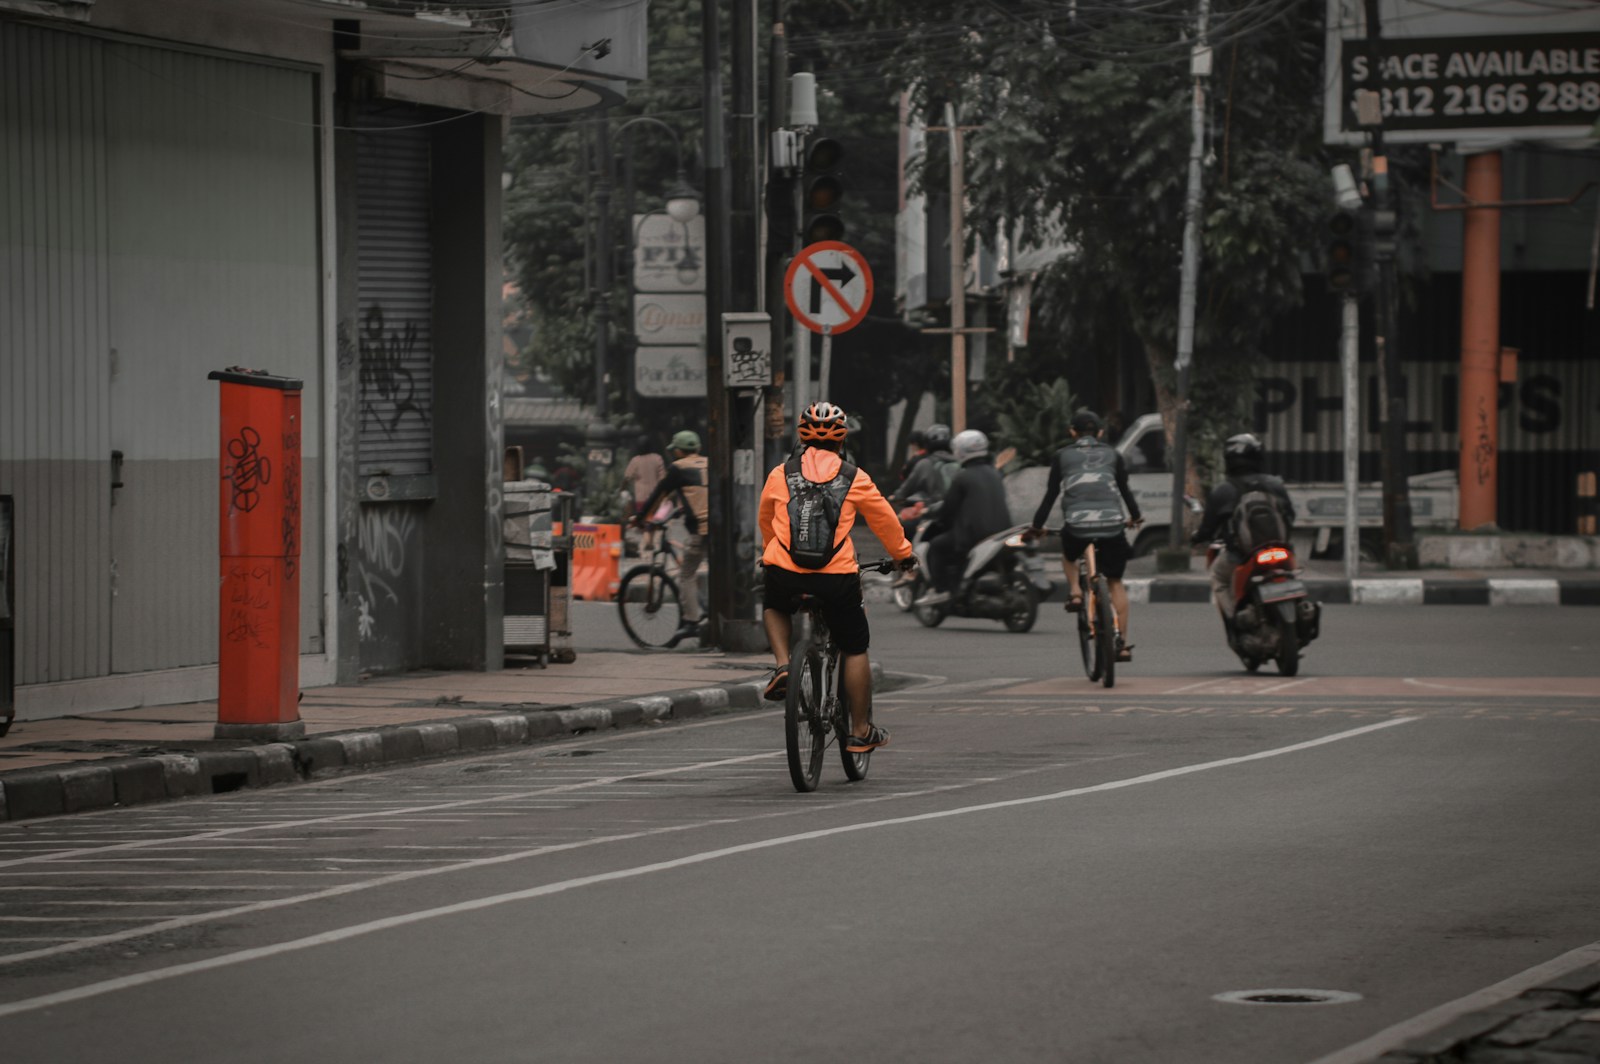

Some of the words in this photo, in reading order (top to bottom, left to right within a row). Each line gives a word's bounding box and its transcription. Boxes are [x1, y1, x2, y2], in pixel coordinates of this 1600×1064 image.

[1352, 54, 1439, 82] SACE
[1444, 48, 1600, 79] AVAILABLE
[1442, 83, 1529, 115] 2166
[1536, 81, 1600, 112] 288
